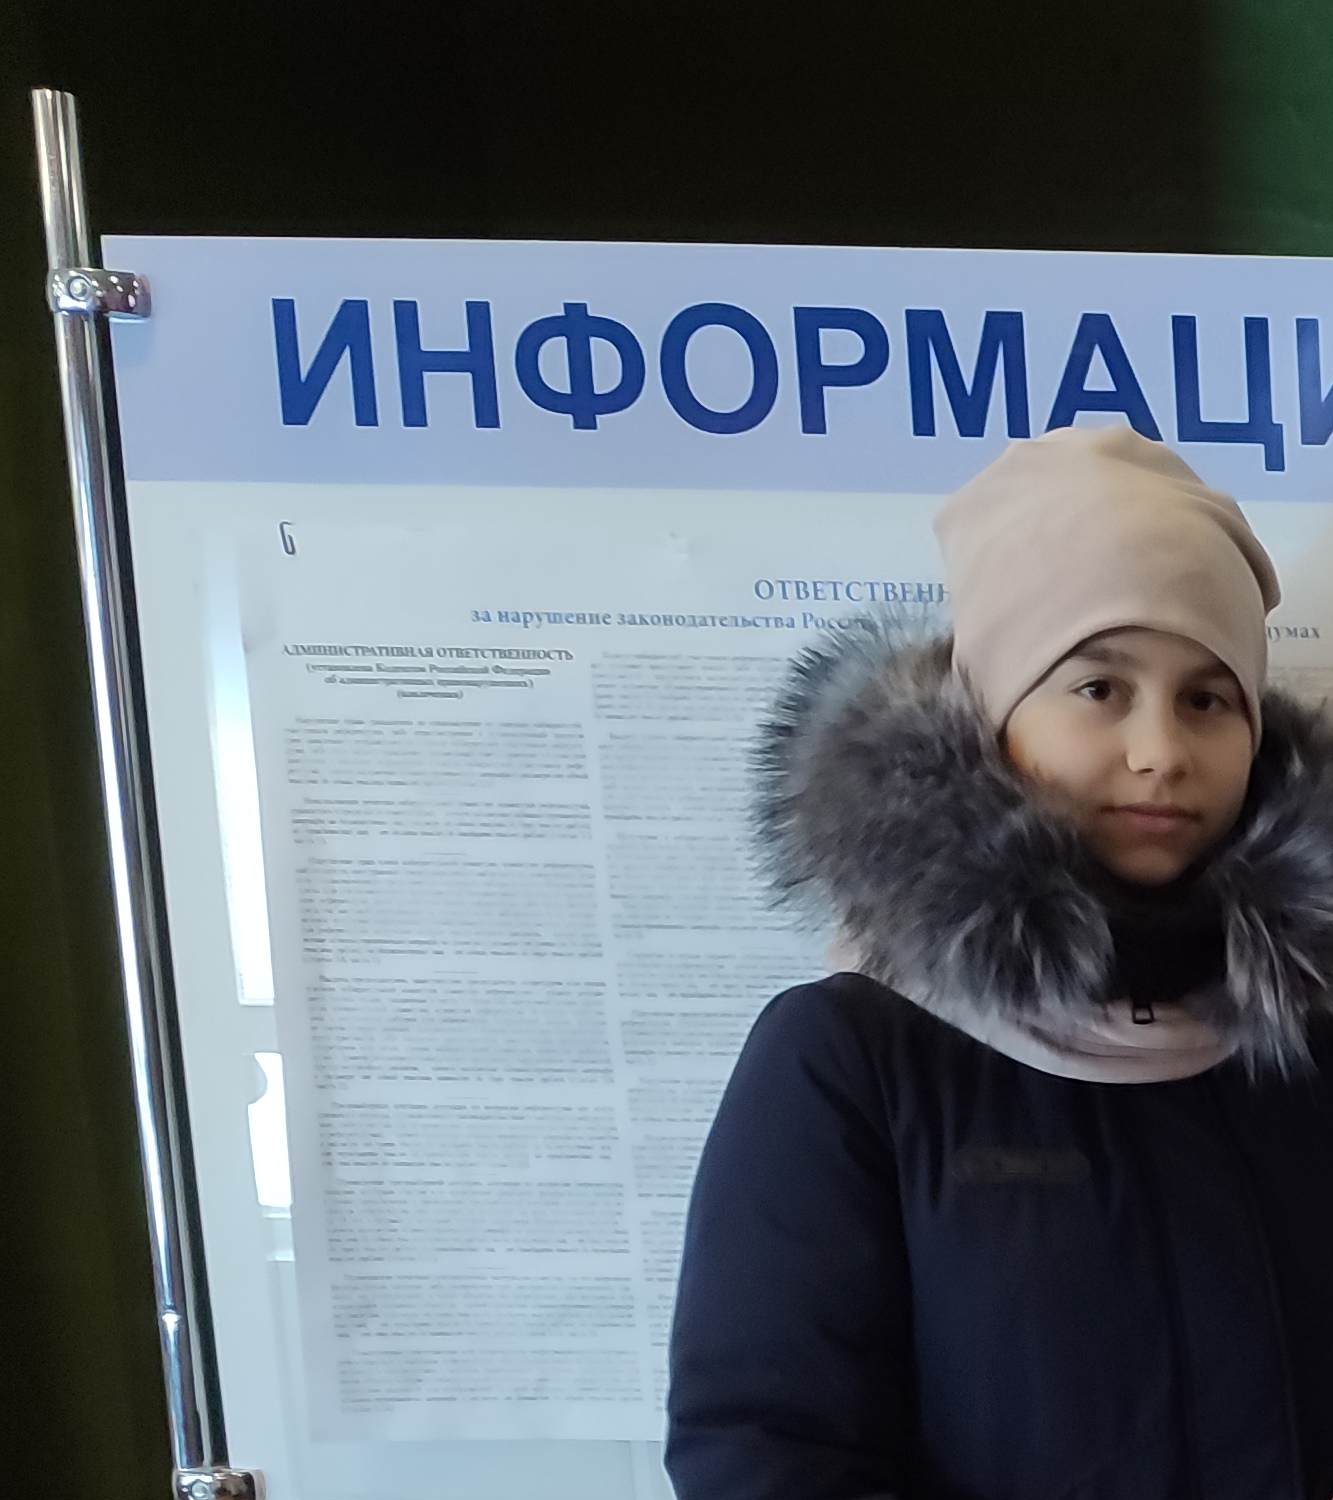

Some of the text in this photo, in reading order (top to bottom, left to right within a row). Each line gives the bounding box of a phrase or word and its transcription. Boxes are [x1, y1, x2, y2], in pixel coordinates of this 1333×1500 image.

[471, 609, 492, 623] за
[498, 610, 612, 629] нарушение
[617, 612, 796, 630] законодательства
